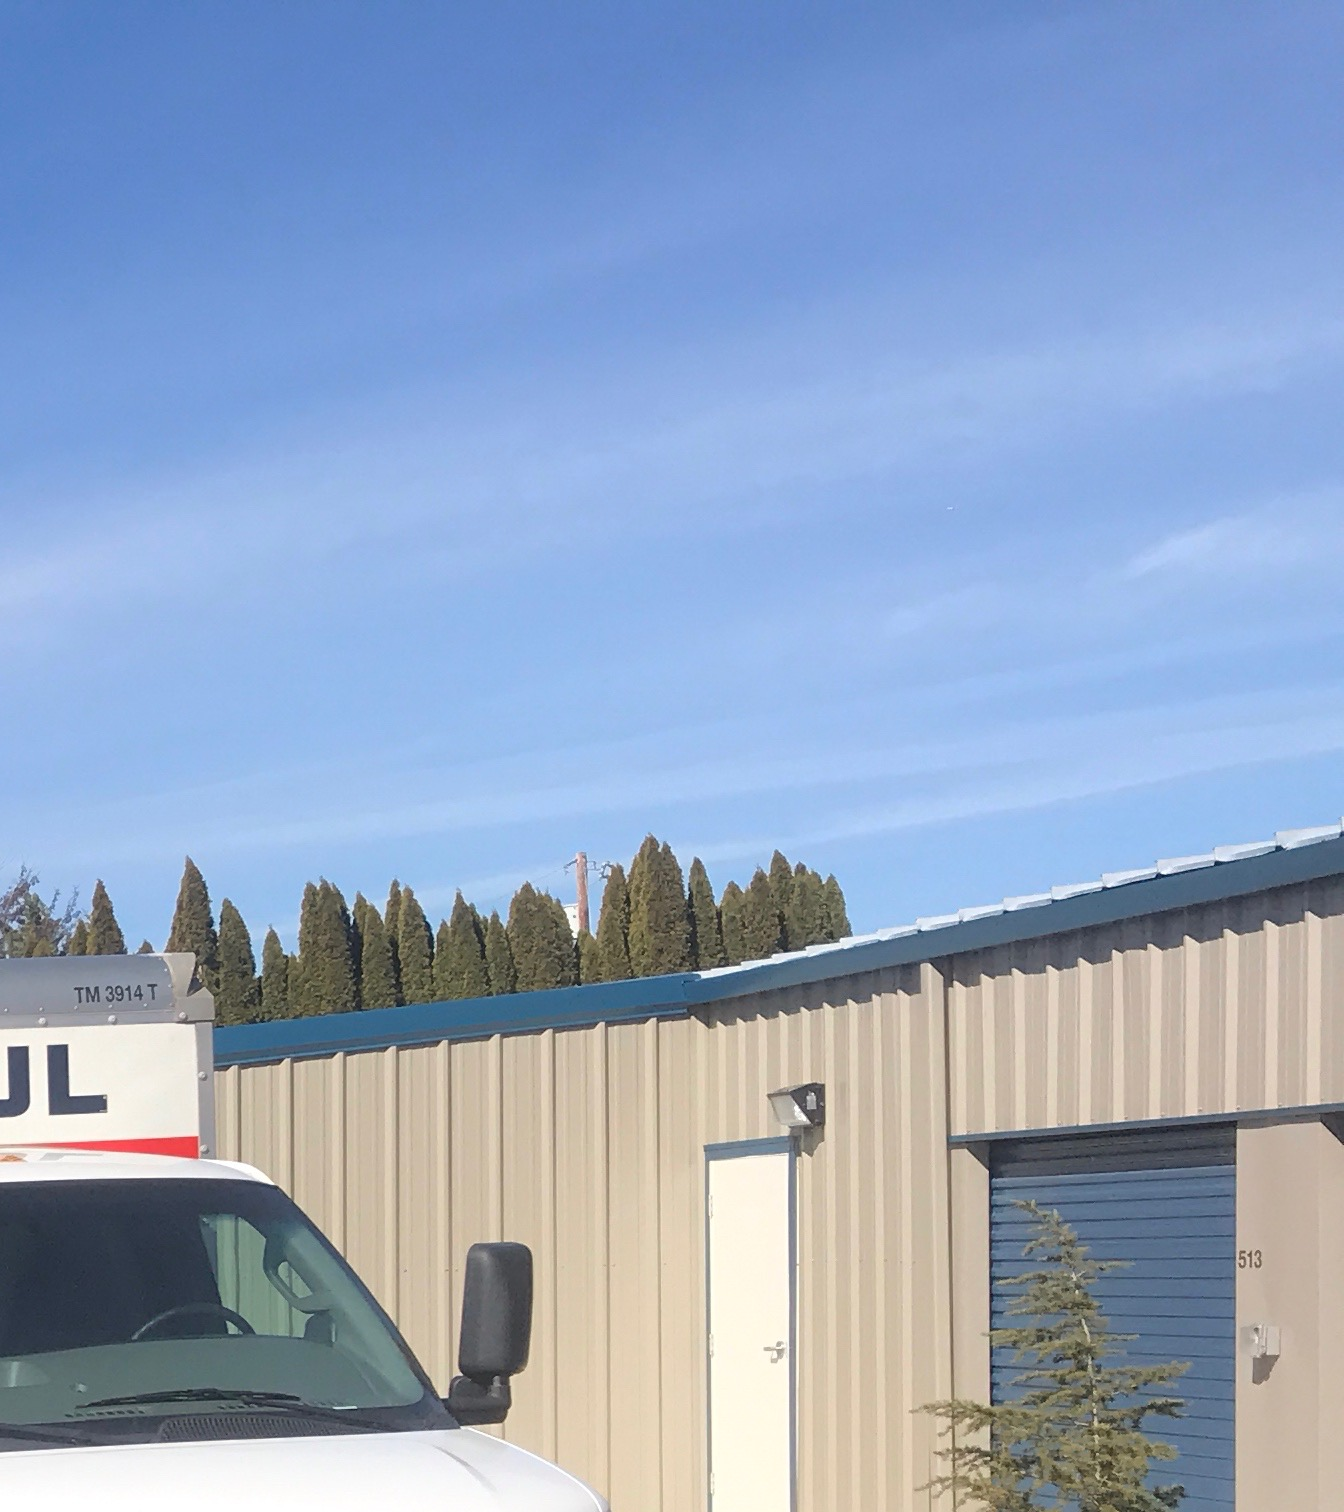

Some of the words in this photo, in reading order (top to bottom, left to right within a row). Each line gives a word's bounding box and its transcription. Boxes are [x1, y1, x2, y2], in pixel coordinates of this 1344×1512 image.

[74, 987, 101, 1003] TM
[105, 985, 143, 1002] 3914
[147, 984, 158, 1000] T
[1238, 1249, 1262, 1269] 513
